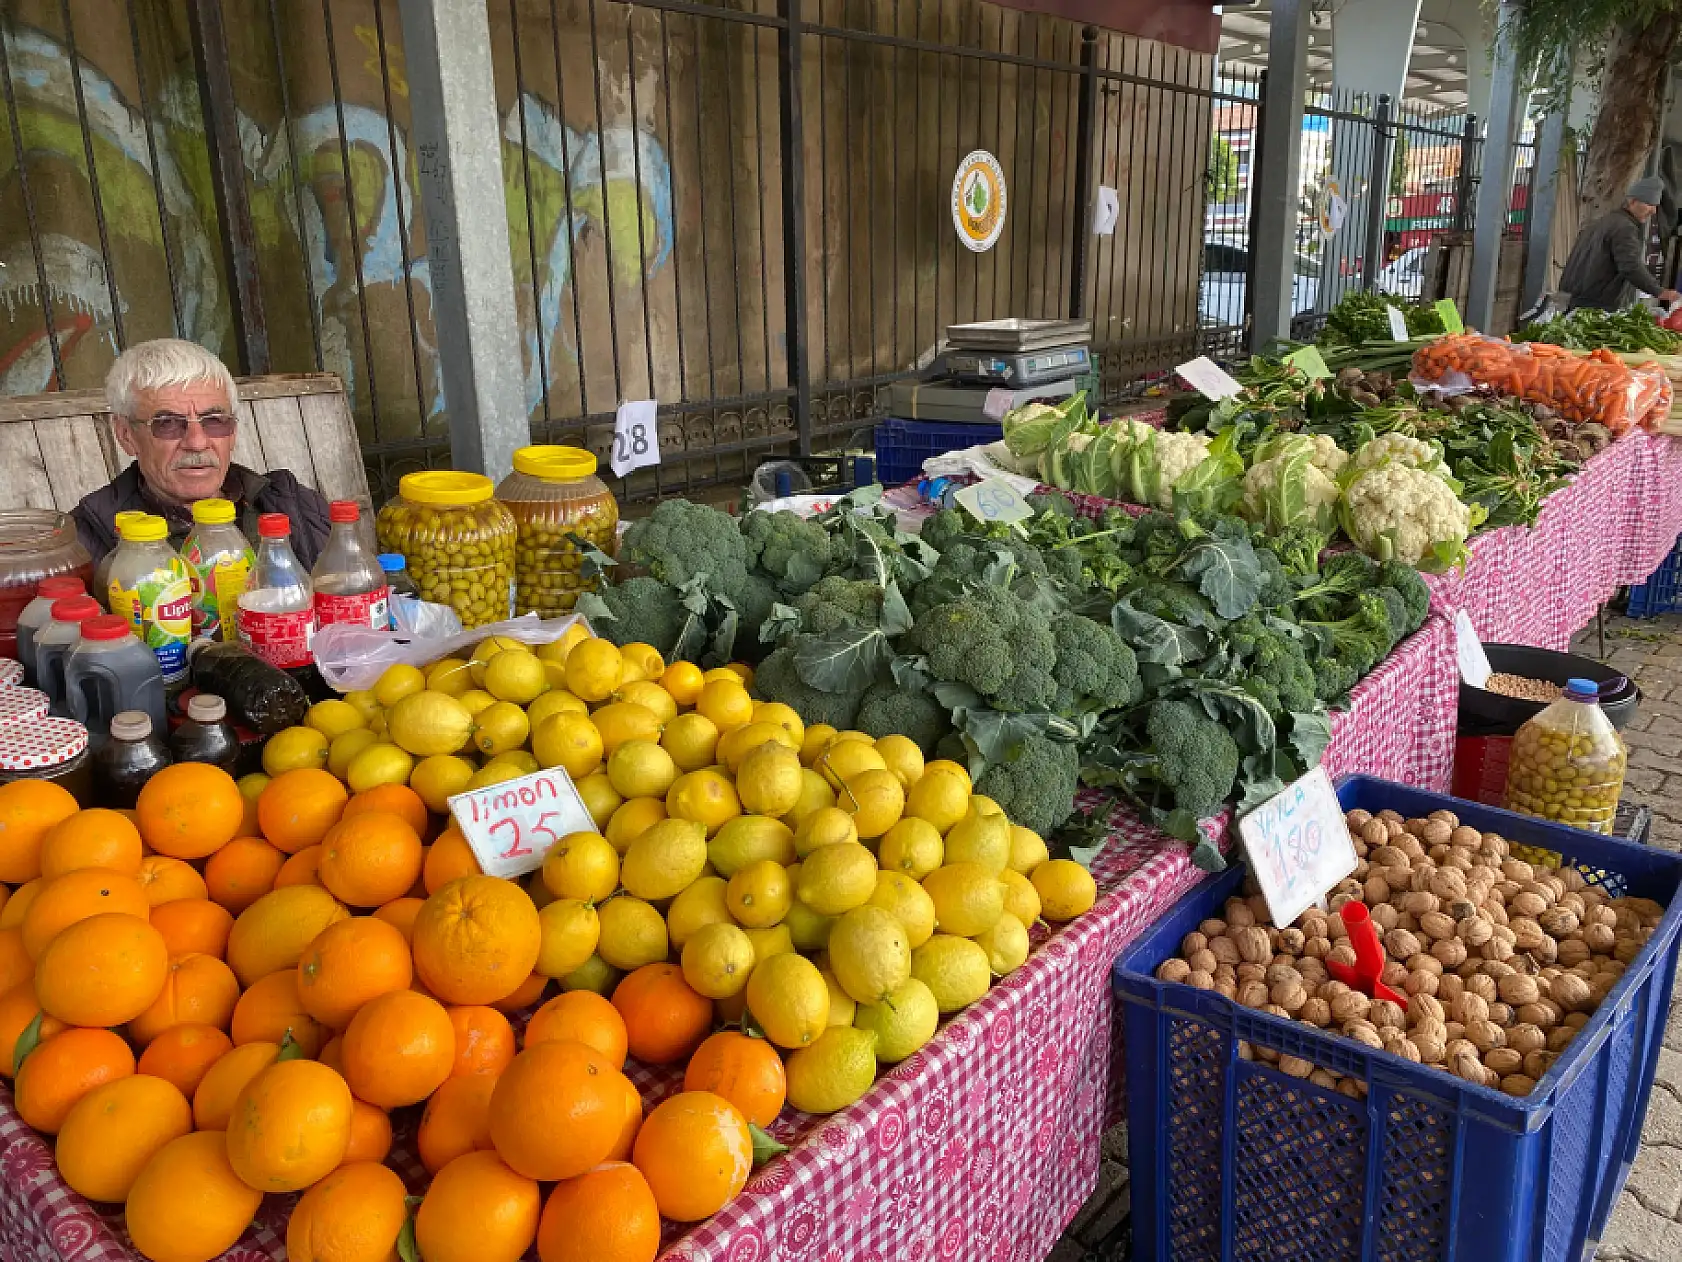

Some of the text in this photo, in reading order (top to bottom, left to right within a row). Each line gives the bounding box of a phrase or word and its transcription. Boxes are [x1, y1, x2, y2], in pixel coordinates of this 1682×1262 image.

[614, 424, 649, 462] 28
[163, 601, 192, 617] Lipt
[470, 777, 558, 822] limon
[488, 811, 561, 860] 25
